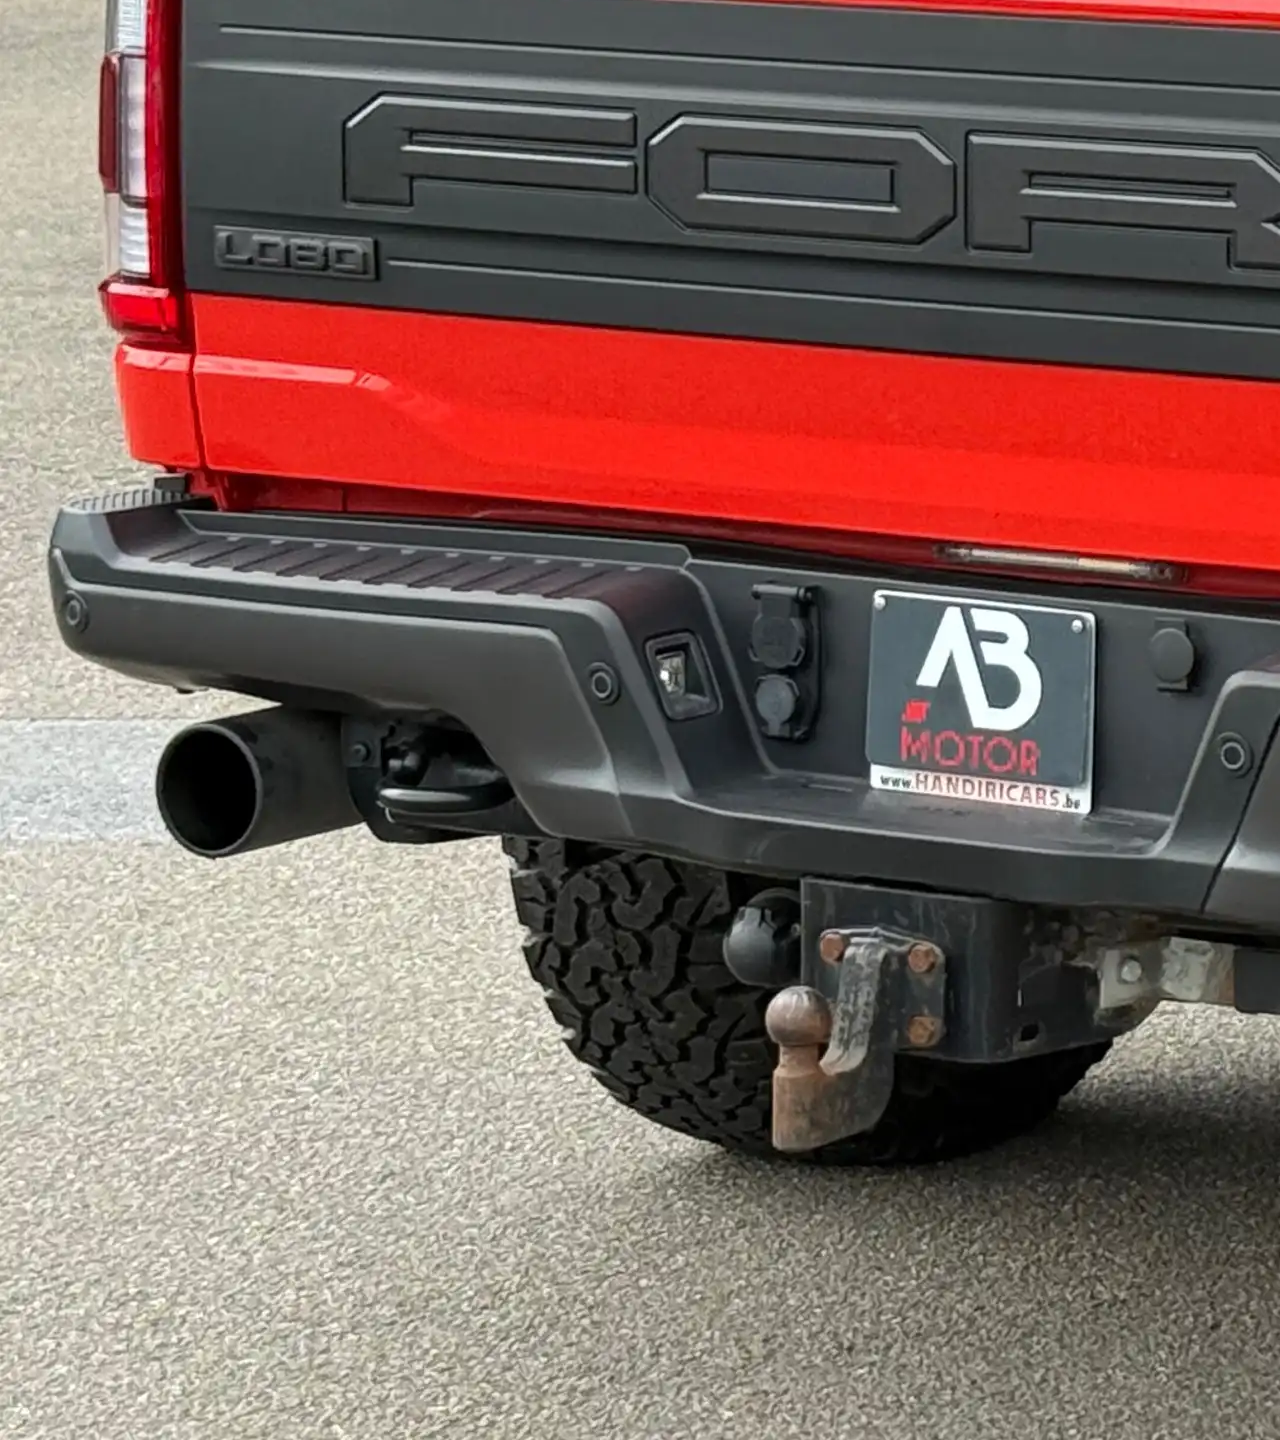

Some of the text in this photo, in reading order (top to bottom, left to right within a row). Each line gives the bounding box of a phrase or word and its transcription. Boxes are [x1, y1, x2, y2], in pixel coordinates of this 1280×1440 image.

[216, 227, 376, 277] LOBO
[915, 606, 1043, 732] AB
[901, 726, 1041, 777] MOTOR
